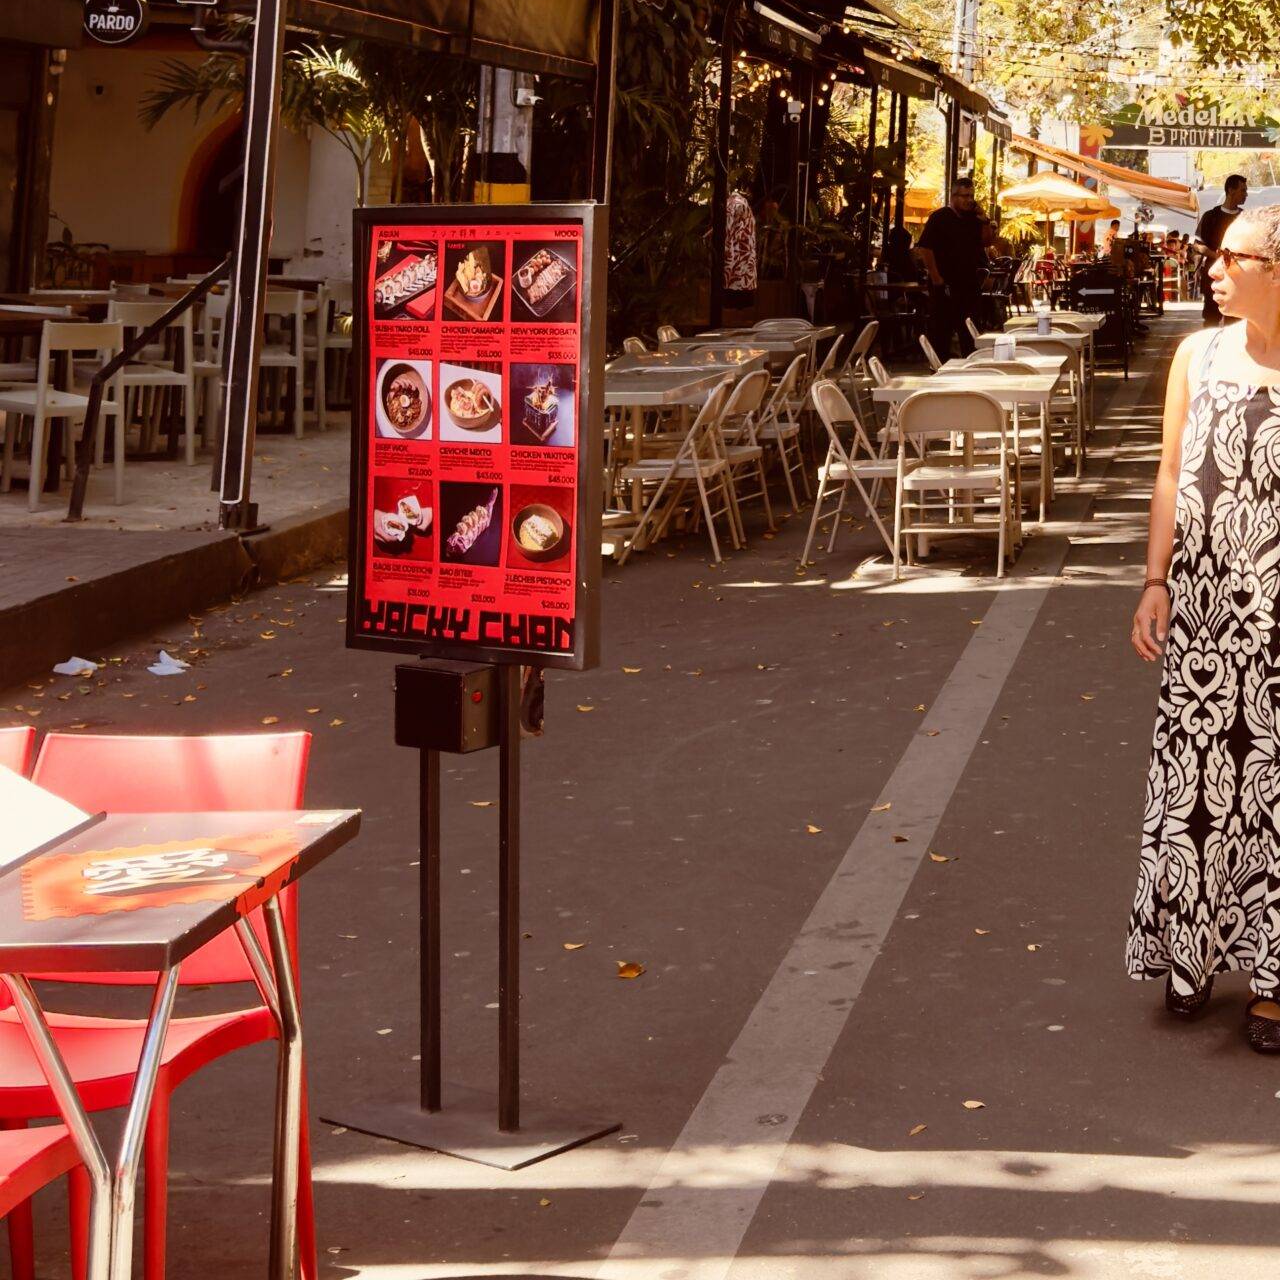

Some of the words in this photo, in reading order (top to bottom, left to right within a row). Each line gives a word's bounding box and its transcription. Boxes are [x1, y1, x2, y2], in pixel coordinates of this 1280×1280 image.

[89, 14, 135, 31] PARDO
[1170, 128, 1242, 147] PROVENZA
[554, 229, 578, 238] MOOD
[441, 326, 470, 335] CHICKEN
[511, 450, 541, 459] CHICKEN
